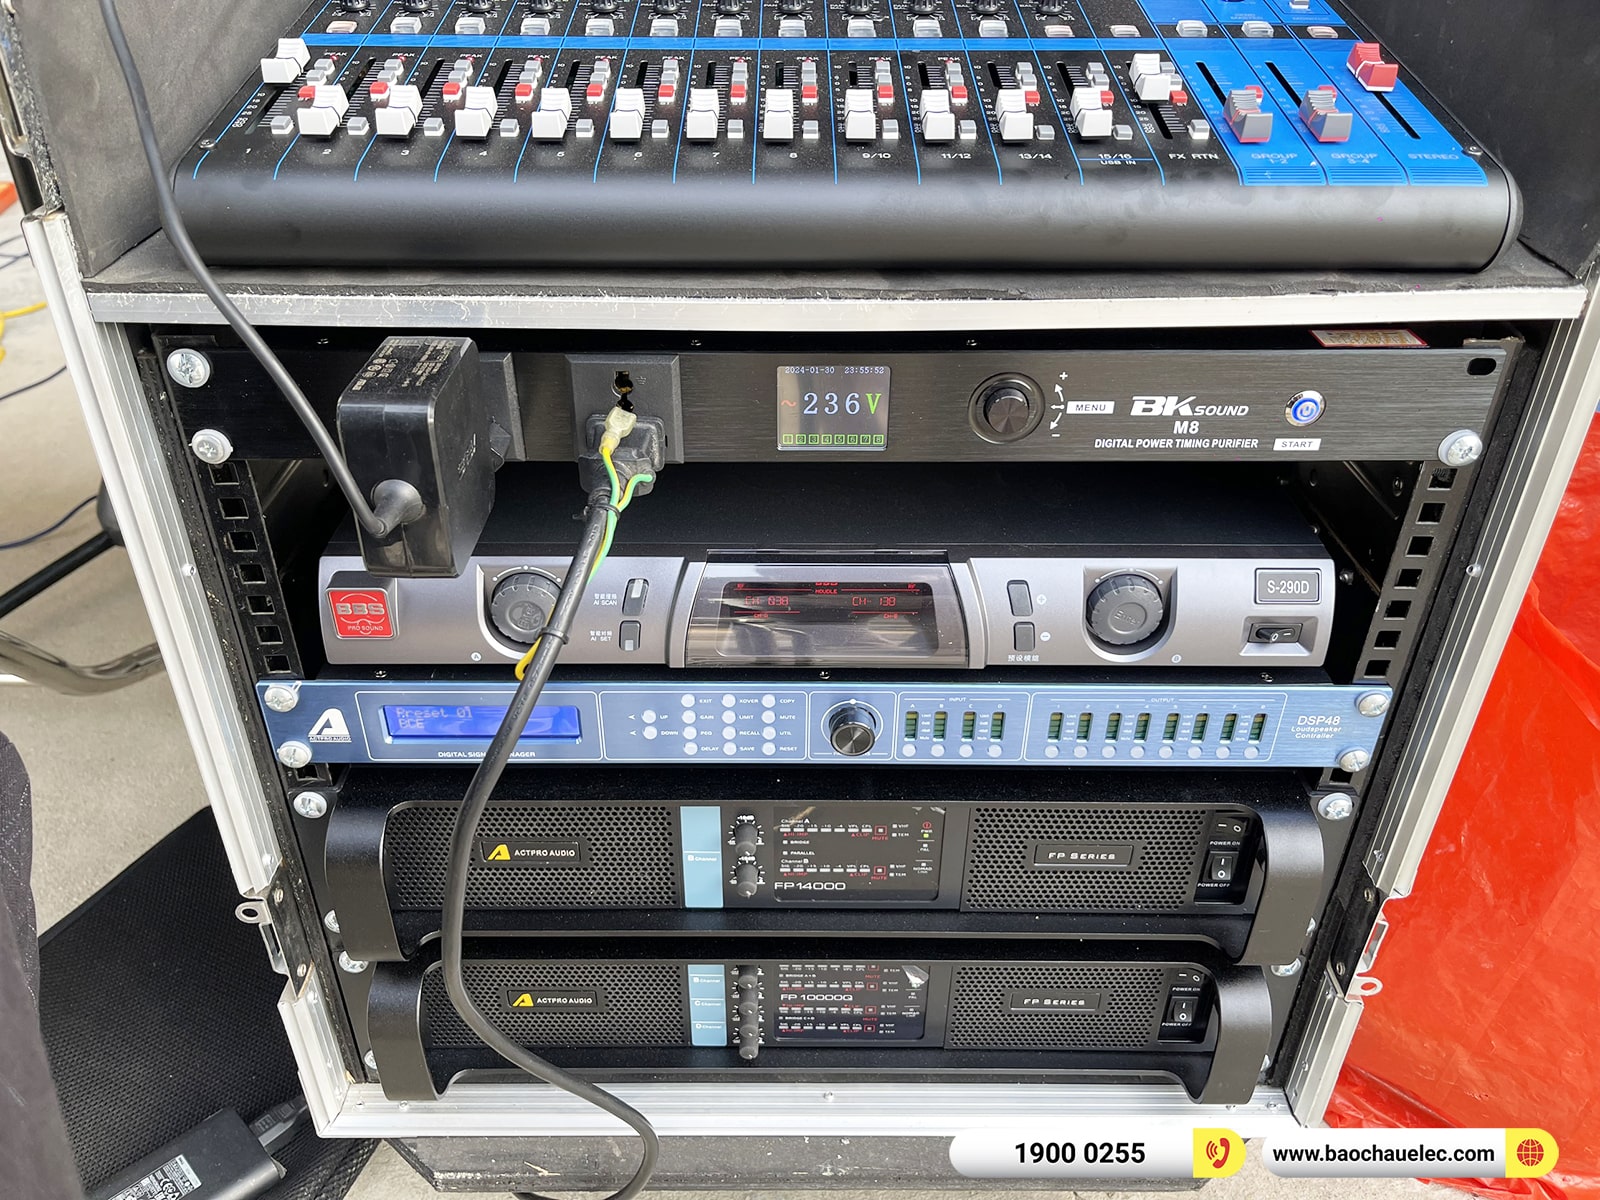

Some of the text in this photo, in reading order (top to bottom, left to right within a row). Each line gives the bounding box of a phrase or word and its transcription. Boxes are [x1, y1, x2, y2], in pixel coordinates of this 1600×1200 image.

[1130, 396, 1248, 416] BK SOUND
[1173, 420, 1200, 434] M8
[1094, 438, 1258, 448] DIGITAL POWER TIMING PURIFIER
[1267, 580, 1310, 595] S-290D
[336, 603, 384, 614] BBS
[456, 706, 472, 718] 01
[1297, 716, 1340, 726] DSP48
